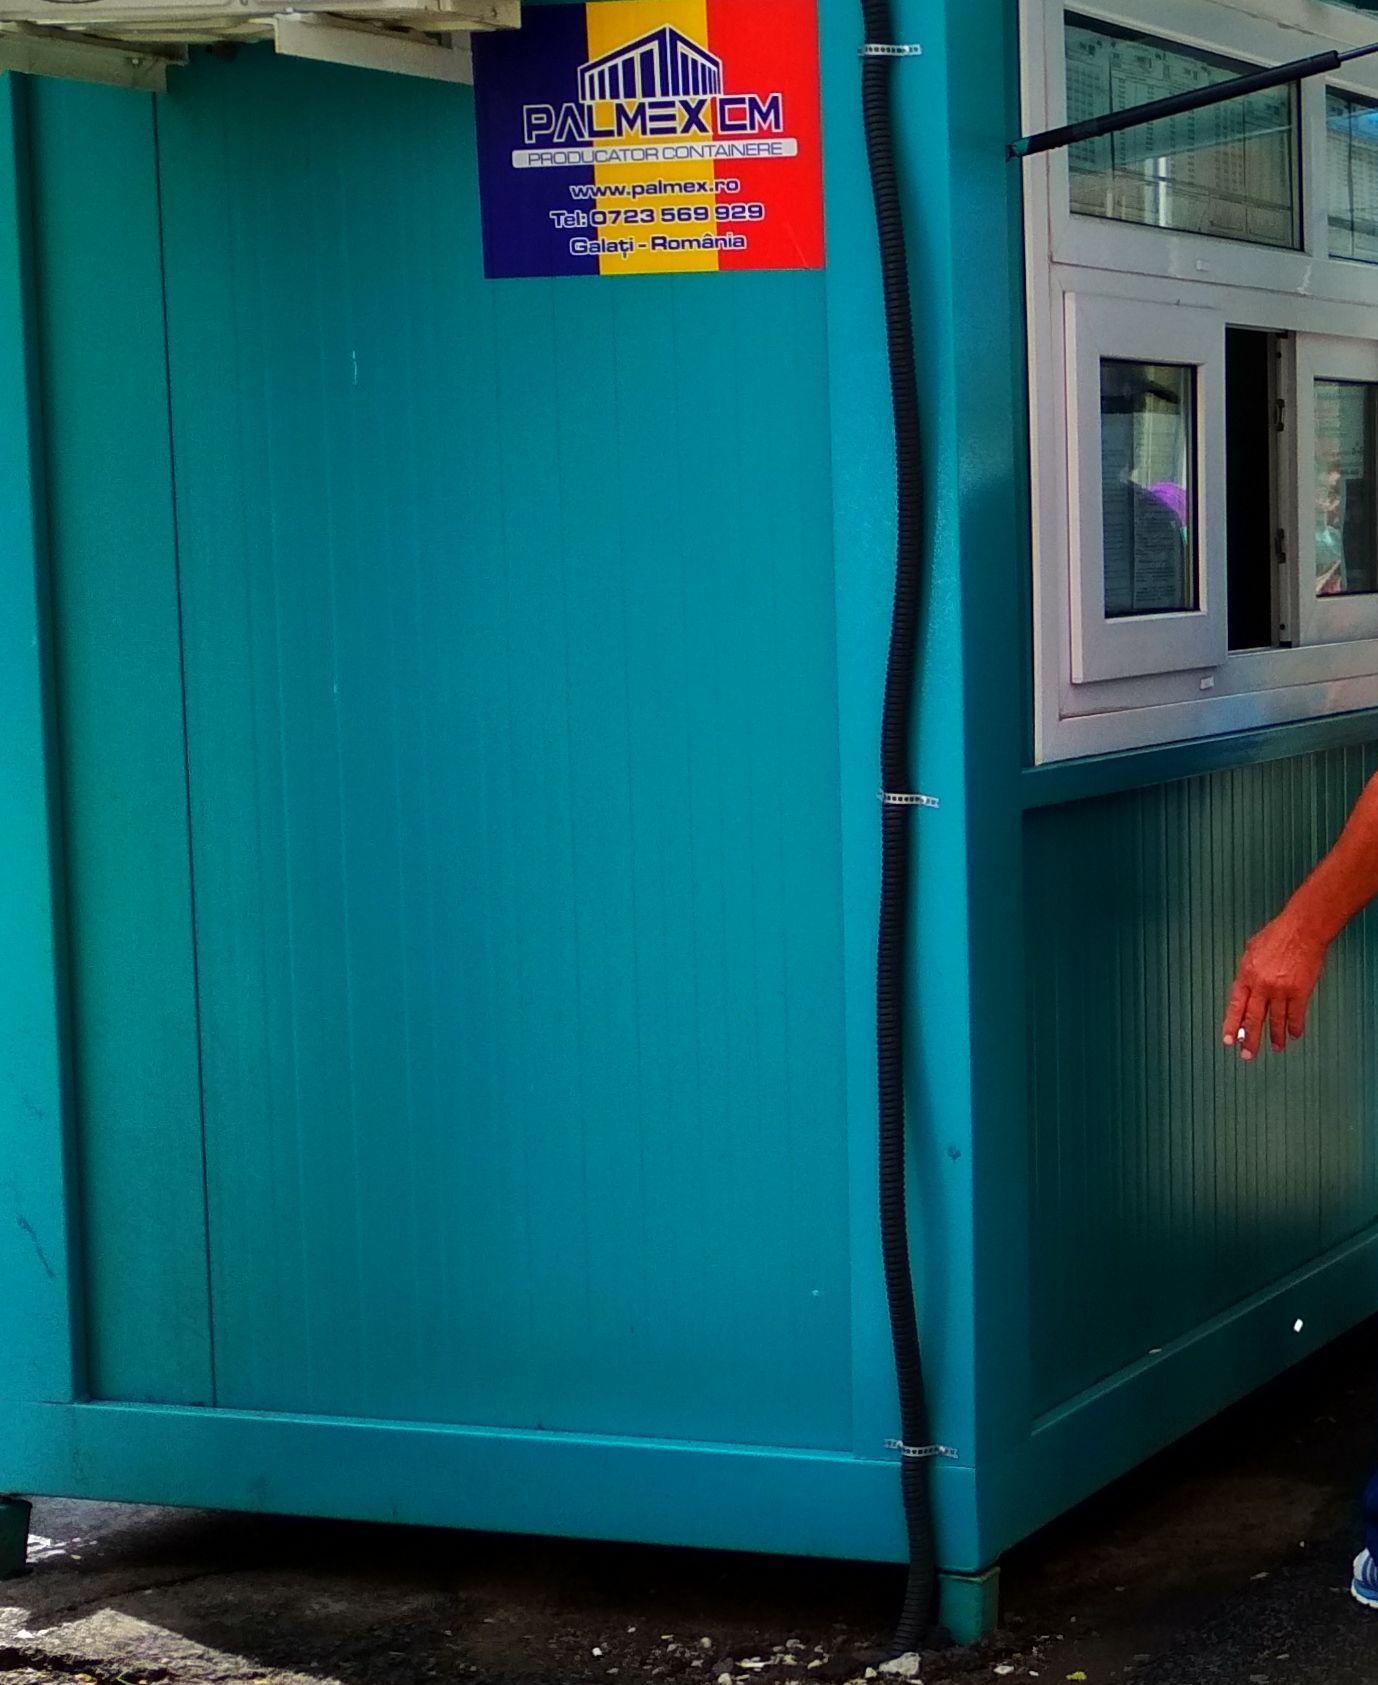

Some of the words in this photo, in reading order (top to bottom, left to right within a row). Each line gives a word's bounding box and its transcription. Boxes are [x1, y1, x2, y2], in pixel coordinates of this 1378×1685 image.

[523, 97, 713, 143] PALMEX
[716, 93, 783, 135] CM
[528, 147, 659, 166] PRODUCATOR
[662, 142, 783, 160] CONTAINERE
[569, 178, 741, 200] www.palmex.ro
[549, 210, 588, 228] Tel:
[589, 208, 655, 227] 0723
[660, 205, 710, 225] 569
[714, 202, 765, 222] 929
[650, 232, 748, 252] România
